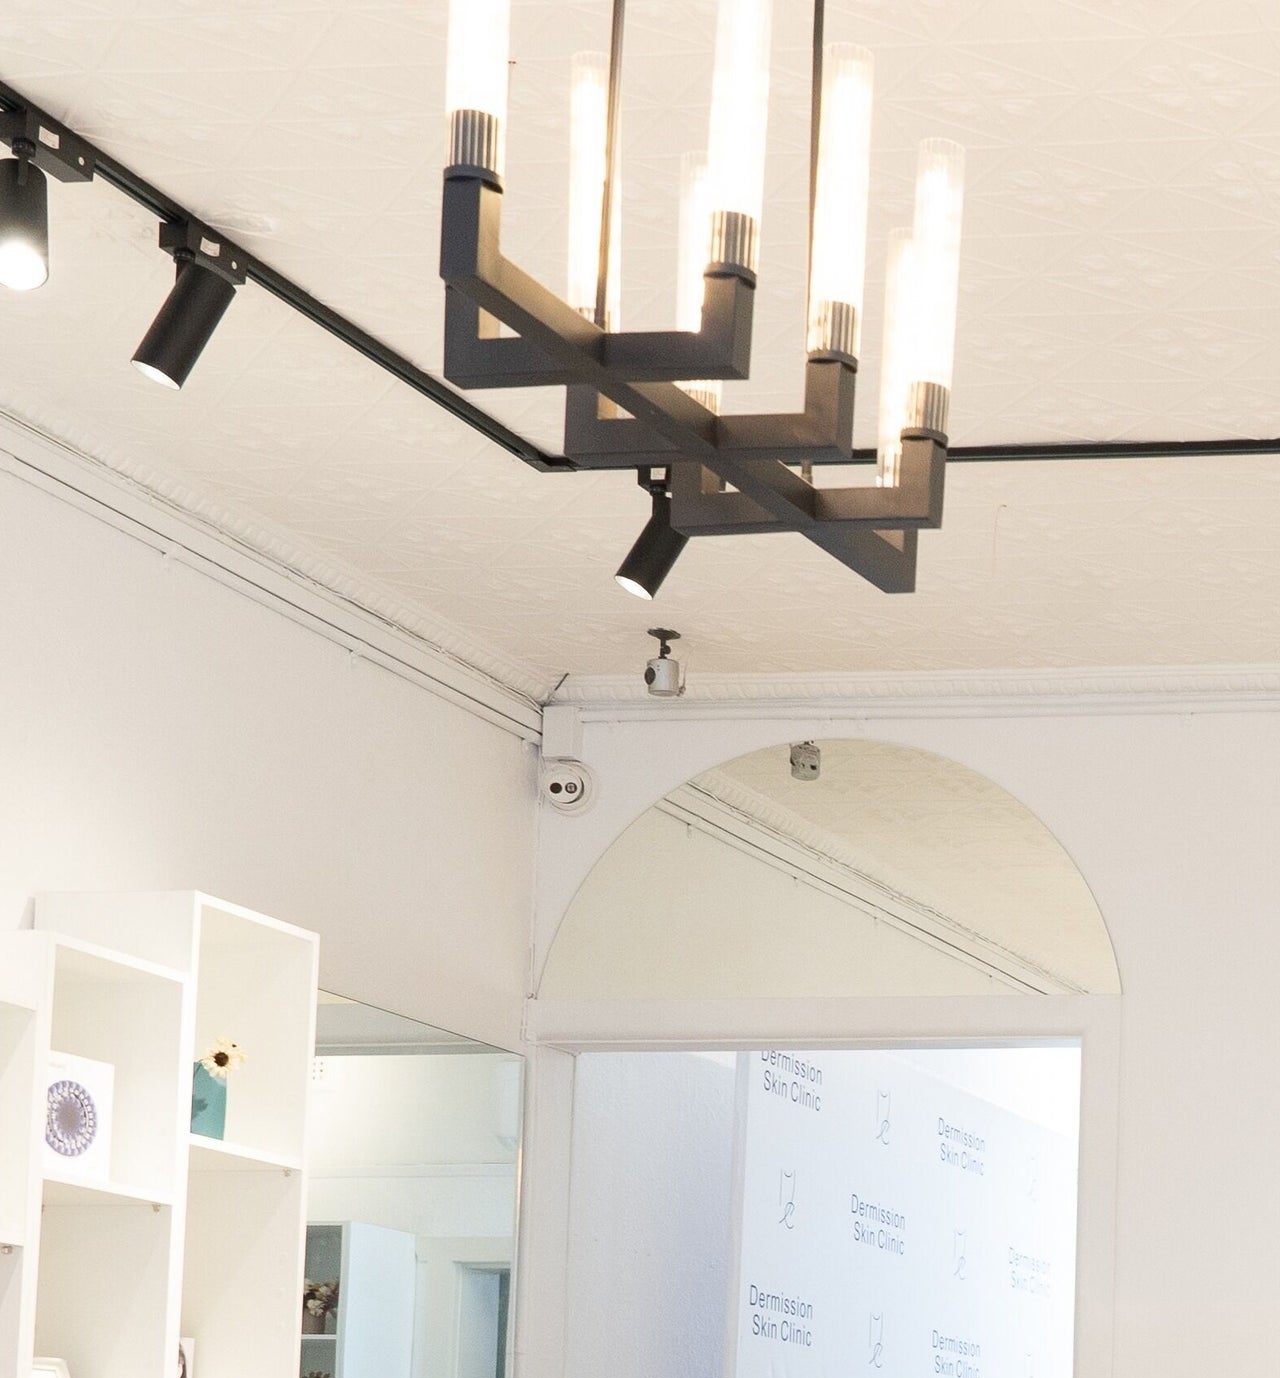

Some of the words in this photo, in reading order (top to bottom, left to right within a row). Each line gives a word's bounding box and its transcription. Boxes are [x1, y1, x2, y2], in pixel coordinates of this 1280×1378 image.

[764, 1070, 788, 1099] Skin
[791, 1081, 821, 1111] Clinic
[938, 1117, 985, 1152] Dermission
[940, 1143, 959, 1167] Skin
[960, 1147, 985, 1176] Clinic
[851, 1193, 906, 1230] Dermission
[853, 1221, 876, 1247] Skin
[877, 1227, 905, 1255] Clinic
[749, 1284, 813, 1320] Dermission
[752, 1313, 778, 1340] Skin
[780, 1317, 812, 1347] Clinic
[932, 1329, 981, 1358] Dermission
[934, 1354, 954, 1377] Skin
